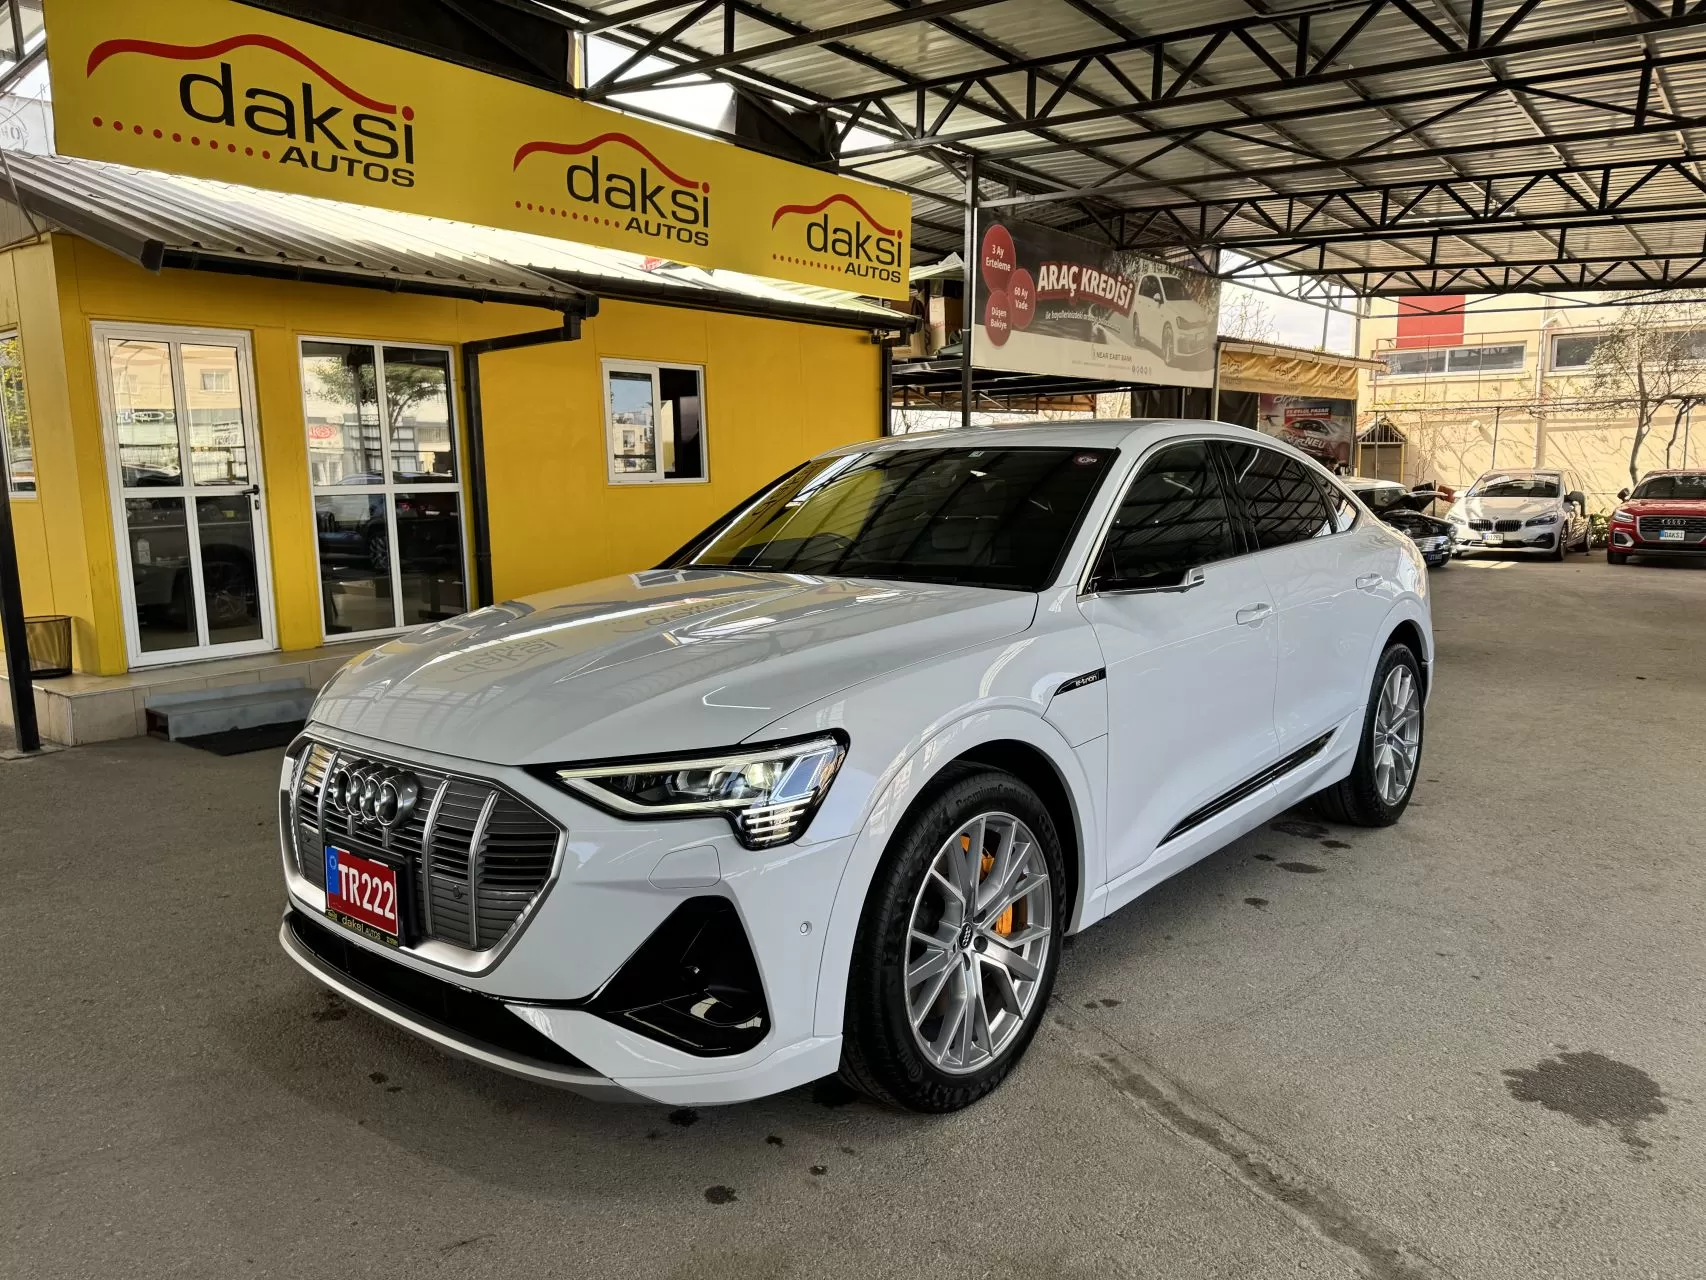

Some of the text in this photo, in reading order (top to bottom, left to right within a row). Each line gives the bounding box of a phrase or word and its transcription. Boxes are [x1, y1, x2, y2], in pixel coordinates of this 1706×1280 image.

[179, 62, 415, 164] daksi
[279, 145, 415, 188] AUTOS
[566, 154, 710, 228] daksi
[624, 216, 709, 247] AUTOS
[806, 213, 903, 268] daksi
[985, 257, 1011, 272] Erteleme
[991, 244, 1005, 258] 3 Ay
[844, 261, 902, 284] AUTOS
[1014, 286, 1029, 300] 60 Ay
[1037, 264, 1134, 310] ARAÇ KREDİSİ
[991, 306, 1007, 318] Düşen
[1015, 299, 1028, 310] Vade
[990, 318, 1007, 331] Bakiye
[338, 863, 395, 920] TR222
